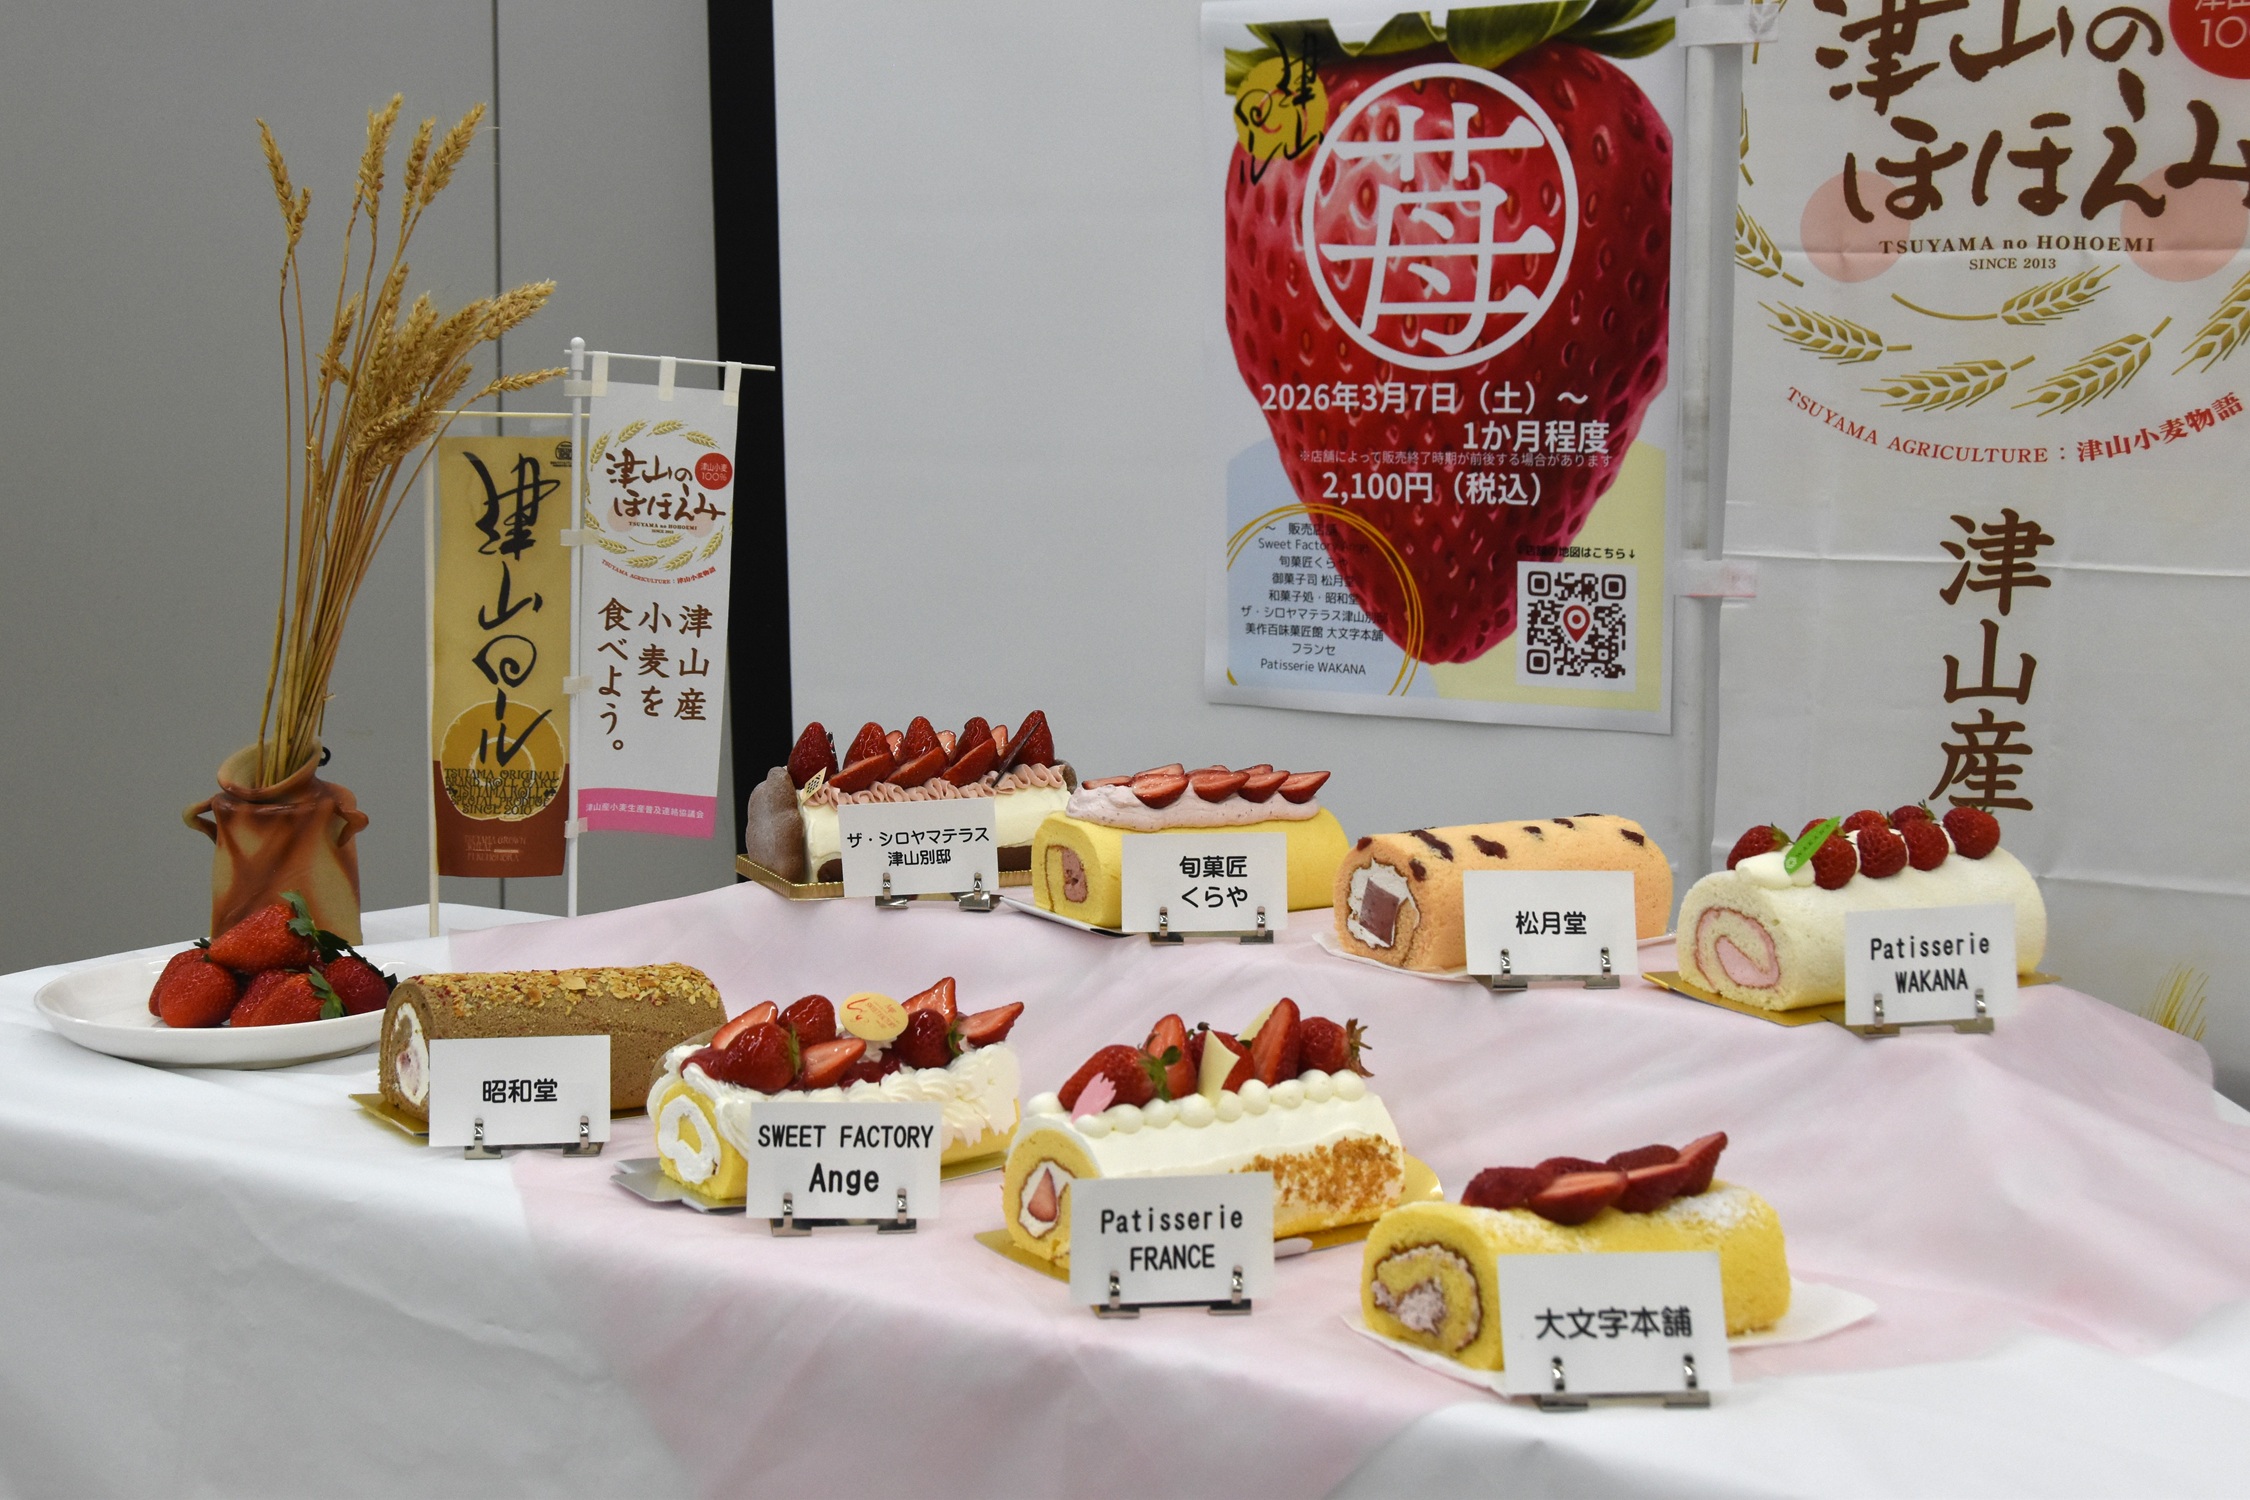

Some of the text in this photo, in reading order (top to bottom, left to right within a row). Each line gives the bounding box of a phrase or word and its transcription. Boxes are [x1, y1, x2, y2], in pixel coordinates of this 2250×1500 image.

[2200, 16, 2250, 50] 10
[1319, 102, 1556, 356] 苺
[1879, 235, 2156, 255] TSUYAMA no HOHOEMI
[1969, 258, 2057, 271] SINCE 2013
[1463, 420, 1610, 454] 1か月程度
[1786, 386, 1878, 446] TSUYAMA
[1887, 436, 2049, 463] AGRICULTURE
[2077, 392, 2246, 463] 津山小麦物語
[605, 448, 693, 489] 津山の
[613, 483, 727, 521] ほほえみ
[1258, 538, 1292, 550] Sweet
[638, 602, 671, 718] 小麦を
[674, 604, 713, 721] 津山産
[1292, 643, 1336, 656] フランセ
[1928, 507, 2055, 811] 津山産
[597, 597, 633, 750] 食べよう。
[1260, 658, 1367, 676] Patisserie WAKANA
[444, 768, 560, 781] TSUYAMA ORIGINAL
[522, 778, 560, 788] CAKE
[462, 804, 532, 815] SINCE 2010
[847, 827, 990, 848] ザ・シロヤマテラス
[887, 849, 952, 867] 津山別邸
[1179, 855, 1249, 879] 旬菓匠
[1181, 886, 1249, 909] くらや
[1515, 910, 1587, 935] 松月堂
[1870, 932, 1990, 961] Patisserie
[1895, 968, 1969, 994] WAKANA
[482, 1078, 558, 1104] 昭和堂
[758, 1124, 934, 1149] SWEET FACTORY
[809, 1162, 880, 1196] Ange
[1101, 1204, 1243, 1234] Patisserie
[1130, 1243, 1216, 1271] FRANCE
[1534, 1305, 1693, 1340] 大文字本舗
